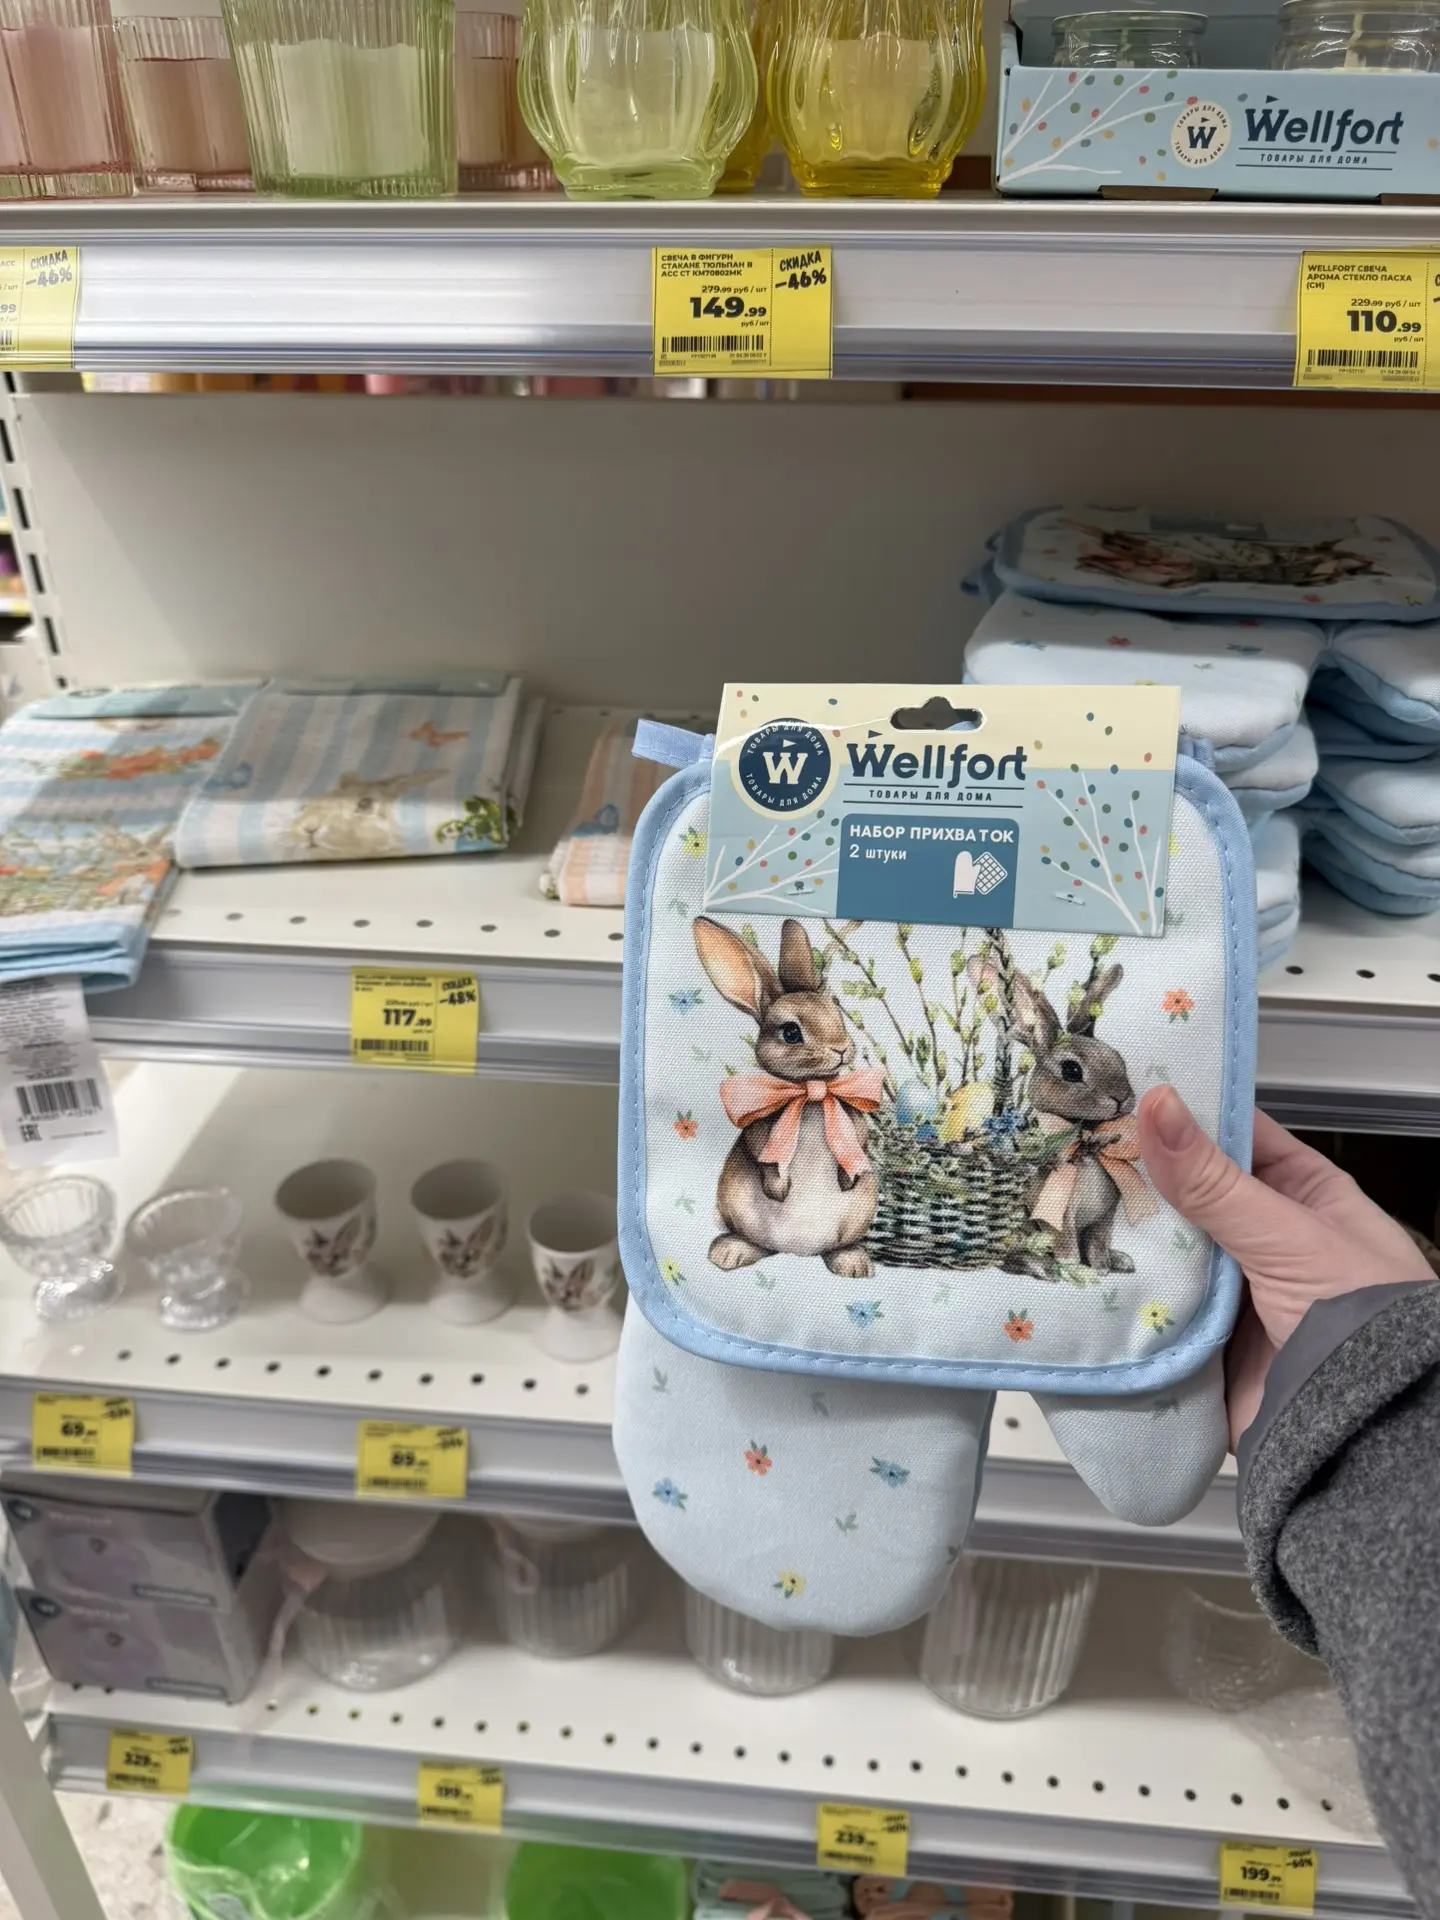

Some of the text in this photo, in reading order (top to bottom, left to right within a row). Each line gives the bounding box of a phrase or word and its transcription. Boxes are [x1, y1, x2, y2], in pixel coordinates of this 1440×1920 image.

[1187, 126, 1217, 149] W
[1245, 109, 1404, 152] Wellfort
[1260, 153, 1368, 164] ТОВАРЫ ДЛЯ ДОМА
[30, 249, 69, 270] СКИДКА
[661, 262, 700, 270] СТАКАНЕ
[779, 250, 822, 272] СКИДКА
[1357, 265, 1387, 273] СВЕЧА
[26, 265, 73, 287] -46%
[775, 268, 827, 290] -46%
[1306, 282, 1325, 290] (СИ)
[1380, 274, 1412, 282] ПАСХА
[702, 285, 732, 293] 279.99
[733, 286, 749, 294] руб
[690, 296, 767, 319] 149.99
[1351, 298, 1383, 307] 229.99
[1385, 300, 1402, 308] руб
[1346, 310, 1422, 333] 110.99
[747, 725, 779, 754] ТОВАРЫ
[804, 731, 824, 756] ДОМА
[762, 752, 809, 785] W
[846, 743, 1028, 788] Wellfort
[746, 773, 823, 807] ТОВАРЫ ДЛЯ ДОМА
[869, 789, 993, 802] ТОВАРЫ ДЛЯ ДОМА
[849, 825, 1015, 844] НАБОР ПРИХВАТОК
[849, 844, 907, 863] 2 штуки
